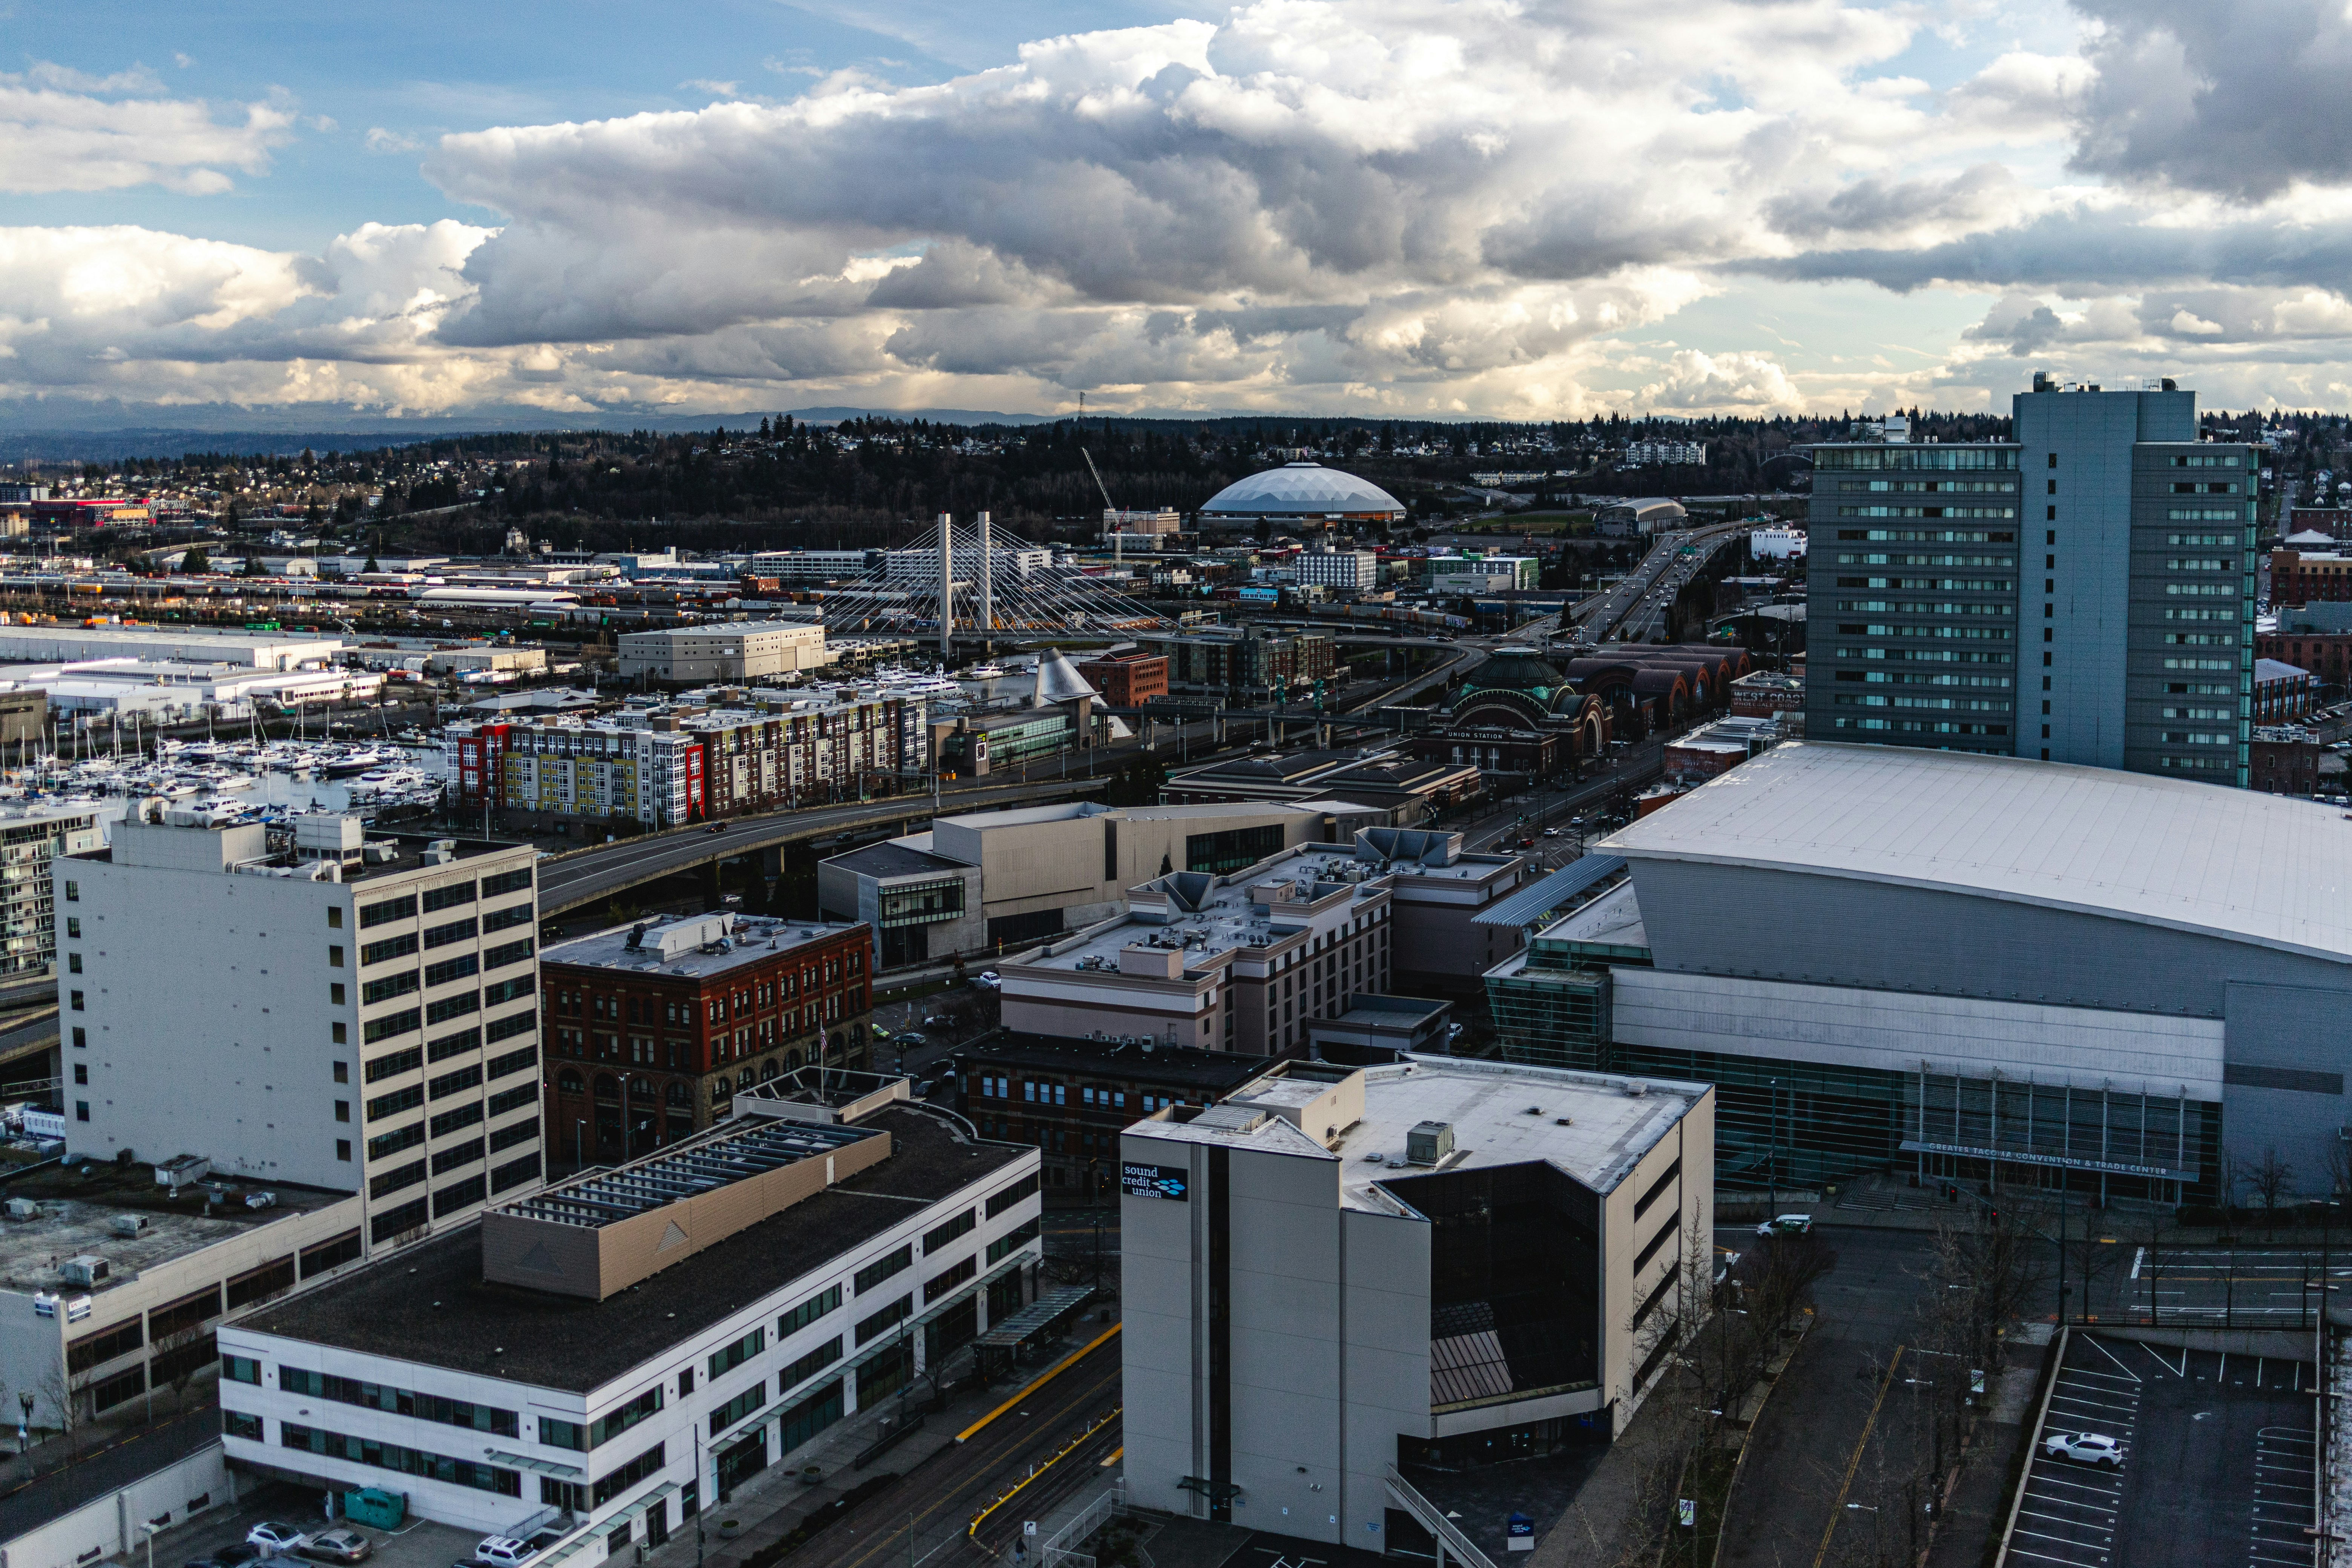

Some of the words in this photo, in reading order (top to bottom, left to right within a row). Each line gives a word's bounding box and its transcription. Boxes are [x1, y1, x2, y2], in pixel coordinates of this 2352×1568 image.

[1734, 691, 1765, 702] WEST
[1929, 1143, 1969, 1153] GREATER
[1973, 1148, 2011, 1158] TACOMA
[2016, 1153, 2080, 1165] CONVENTION
[2096, 1161, 2126, 1171] TRADE
[2130, 1165, 2166, 1175] CENTER
[1125, 1166, 1158, 1178] sound
[1122, 1177, 1151, 1187] credit
[1132, 1187, 1162, 1198] union
